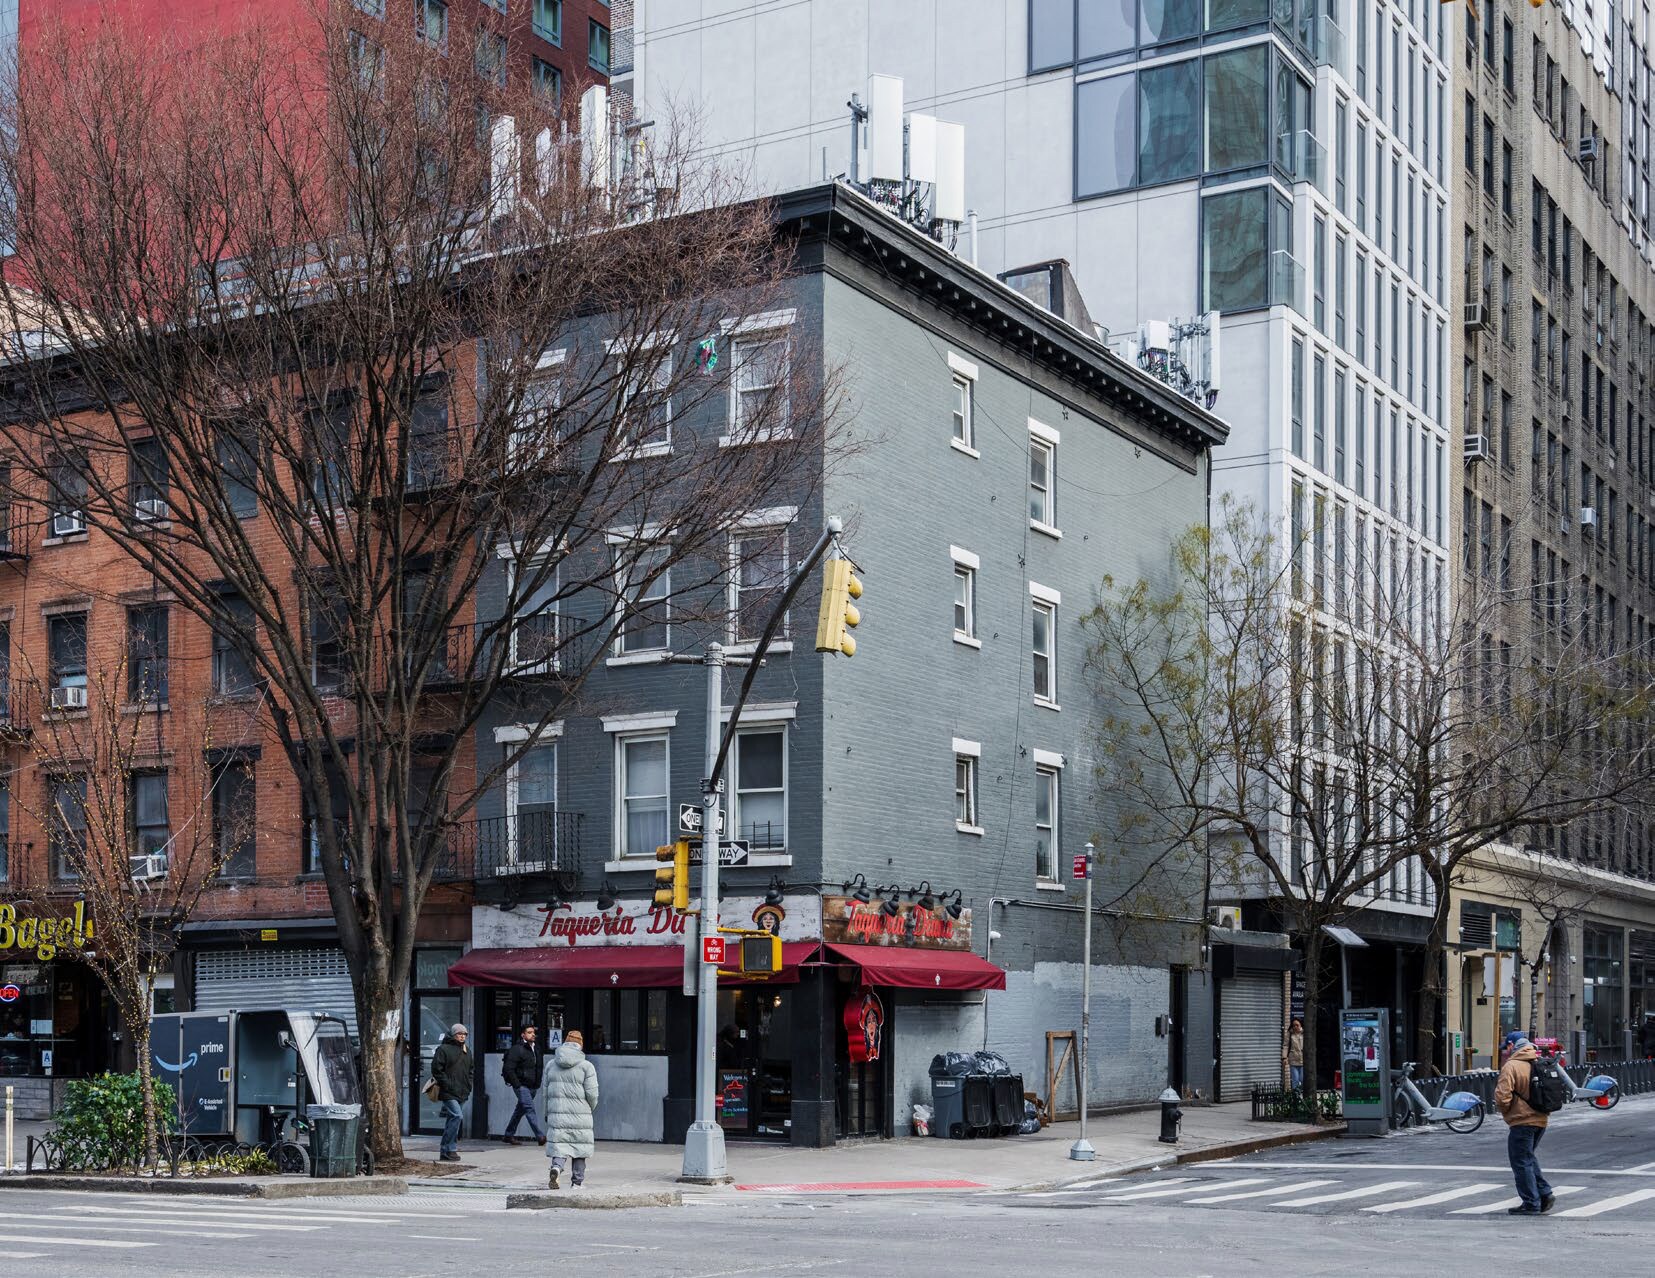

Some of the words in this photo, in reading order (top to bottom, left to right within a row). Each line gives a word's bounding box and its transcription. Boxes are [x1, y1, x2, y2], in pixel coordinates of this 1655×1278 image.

[686, 813, 701, 825] ONE
[689, 848, 703, 859] ON
[718, 848, 740, 859] WAY
[537, 903, 637, 946] Taqueria
[912, 904, 955, 940] Diana
[707, 946, 722, 954] WRONG
[709, 953, 719, 961] WAY
[0, 988, 19, 999] OPEN
[551, 1031, 560, 1043] A
[200, 1041, 224, 1056] prime
[44, 1052, 50, 1062] A
